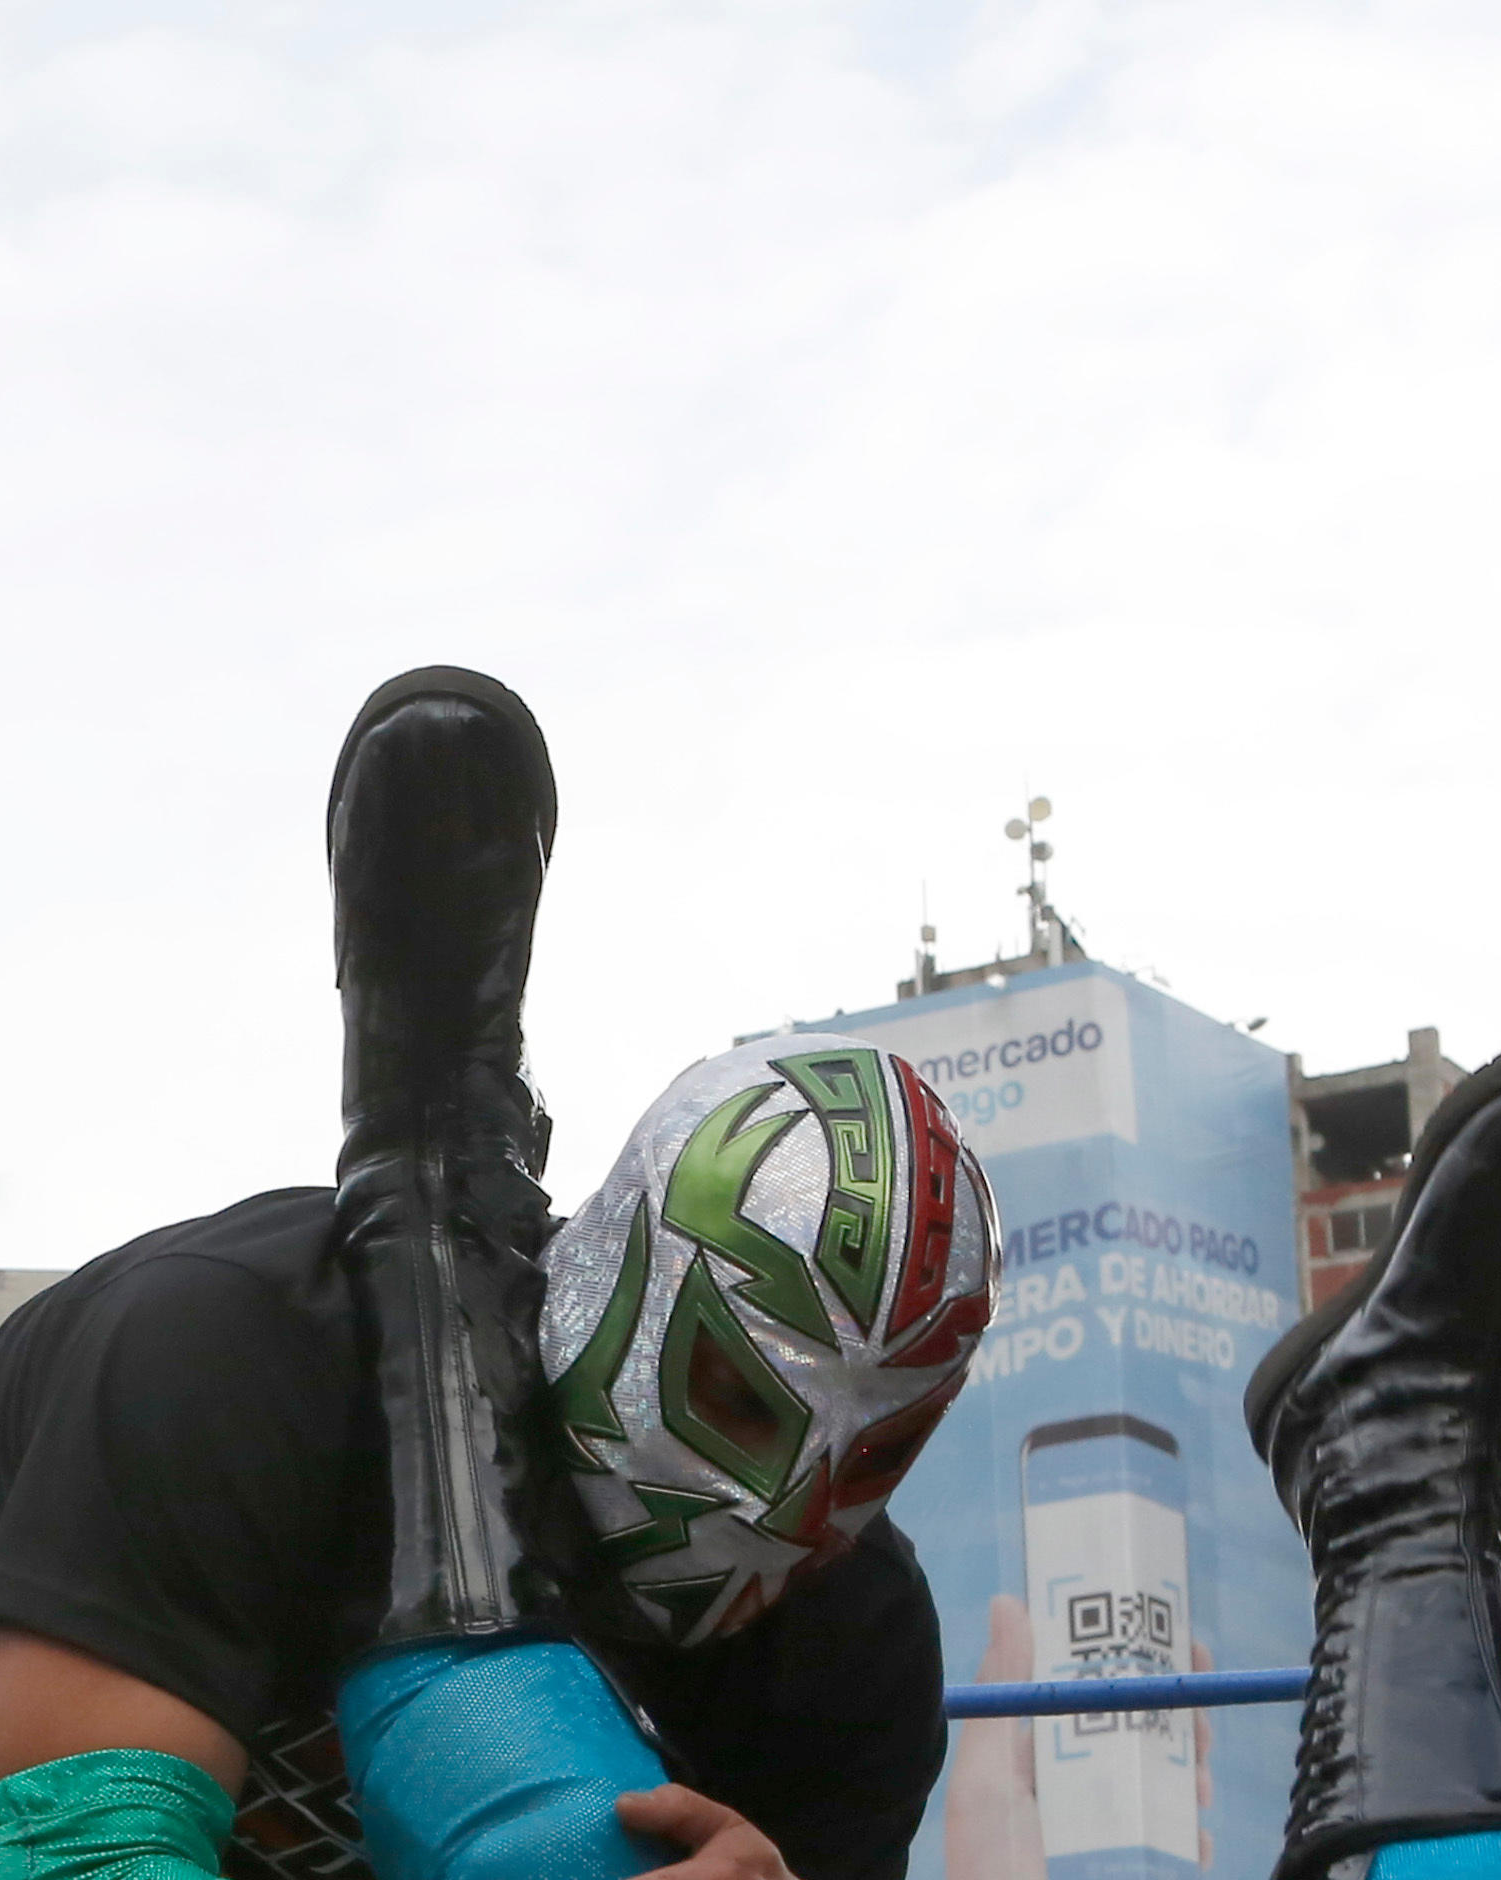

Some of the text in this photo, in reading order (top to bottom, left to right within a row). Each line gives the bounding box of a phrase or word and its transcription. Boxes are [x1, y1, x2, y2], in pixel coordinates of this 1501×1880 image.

[919, 1017, 1103, 1085] mercado
[952, 1080, 1025, 1126] ago
[1189, 1221, 1261, 1276] PAGO
[998, 1262, 1088, 1327] ERA
[1099, 1250, 1148, 1299] DE
[967, 1304, 1236, 1388] MPO Y DINERO
